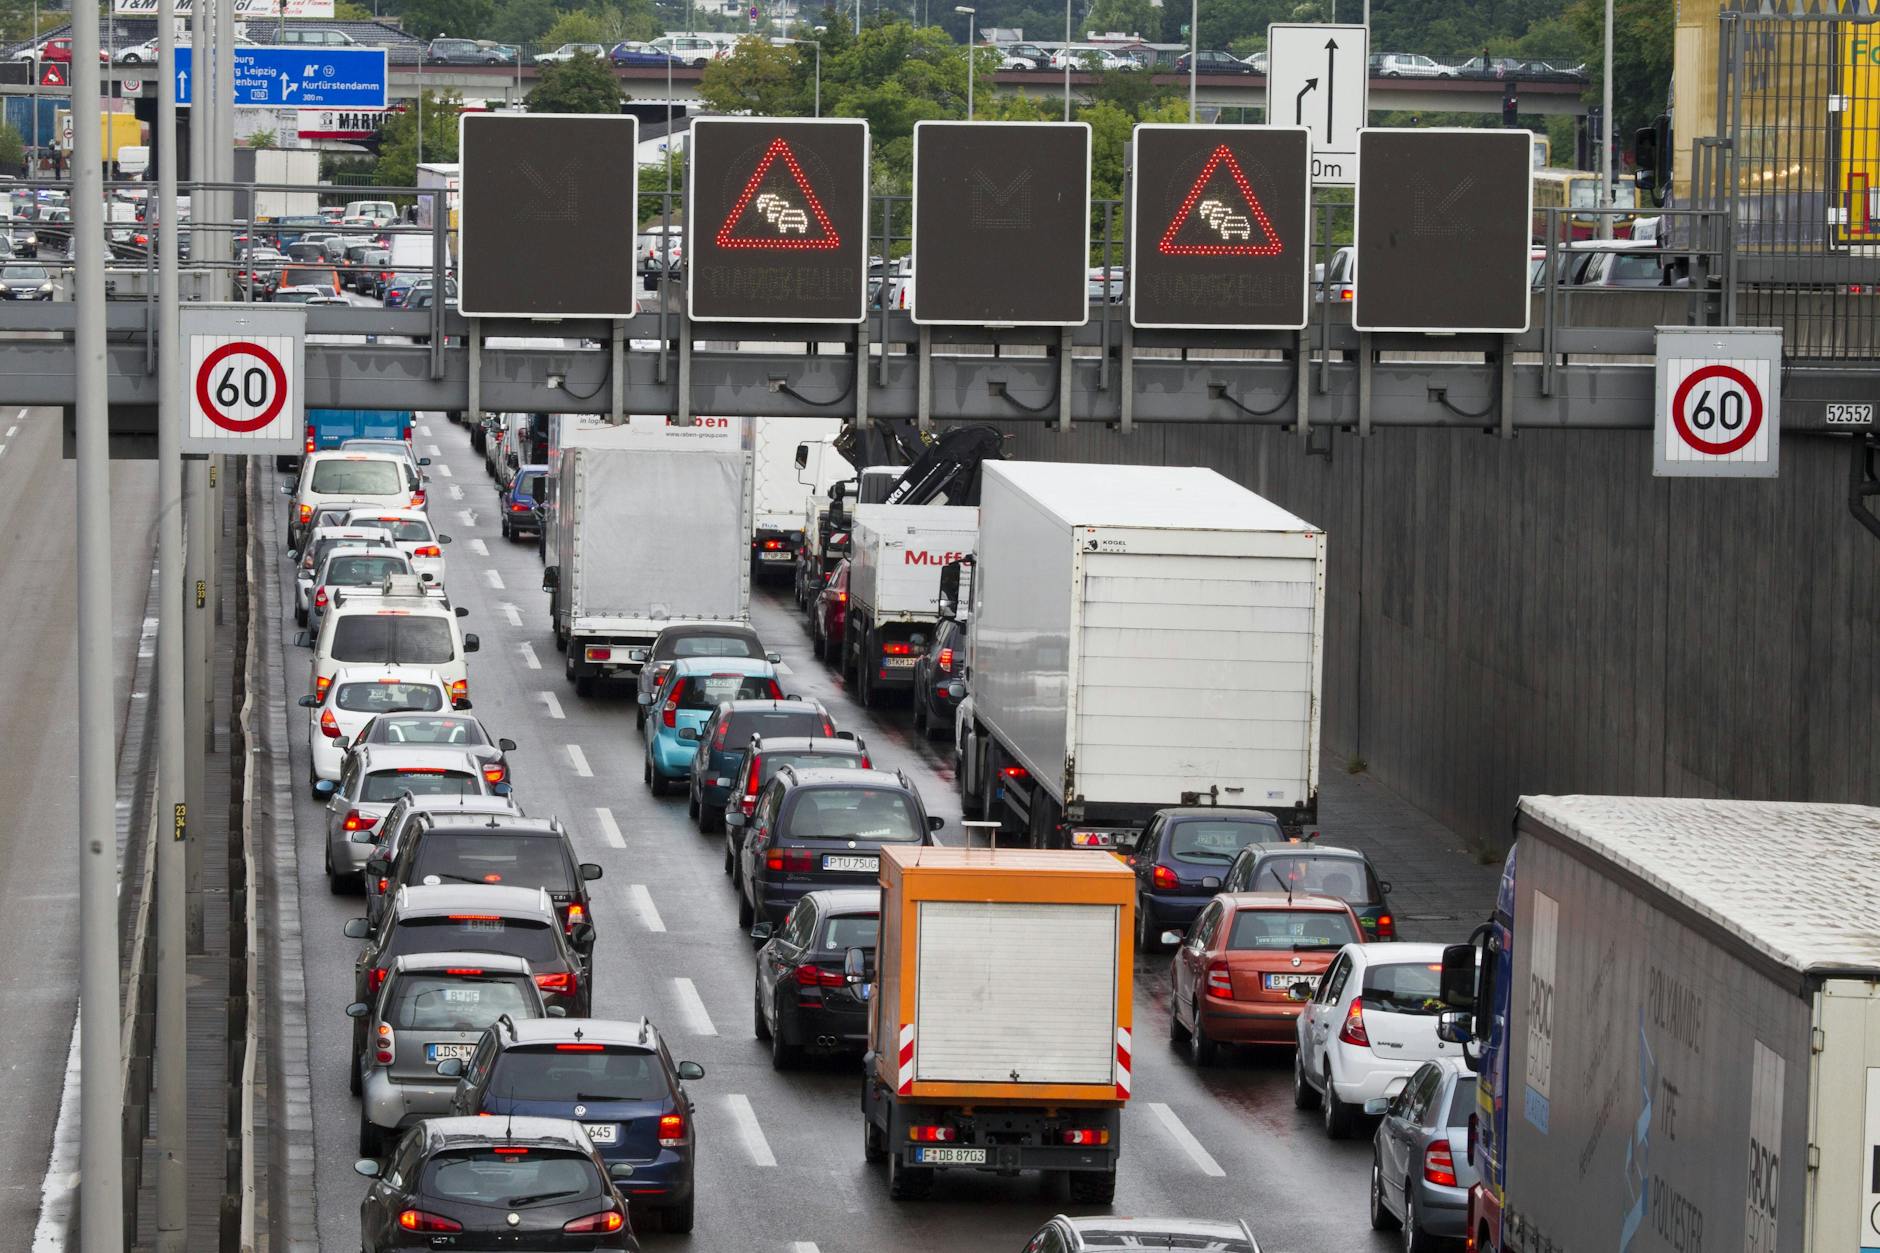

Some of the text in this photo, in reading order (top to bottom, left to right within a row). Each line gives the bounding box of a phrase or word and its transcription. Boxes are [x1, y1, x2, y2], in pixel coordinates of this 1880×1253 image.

[234, 55, 254, 65] burg
[244, 66, 277, 76] Leipzig
[234, 79, 268, 88] enburg
[302, 80, 379, 91] Kurfürstendamm
[216, 367, 267, 408] 60
[1692, 390, 1743, 430] 60
[1827, 404, 1872, 423] 52552
[176, 805, 186, 816] 23
[830, 857, 877, 869] PTU 75UG
[436, 1046, 458, 1057] LDS
[588, 1126, 611, 1138] 645
[923, 1149, 984, 1161] F DB 8703
[1651, 1174, 1703, 1253] POLYESTER
[432, 1236, 448, 1244] 147
